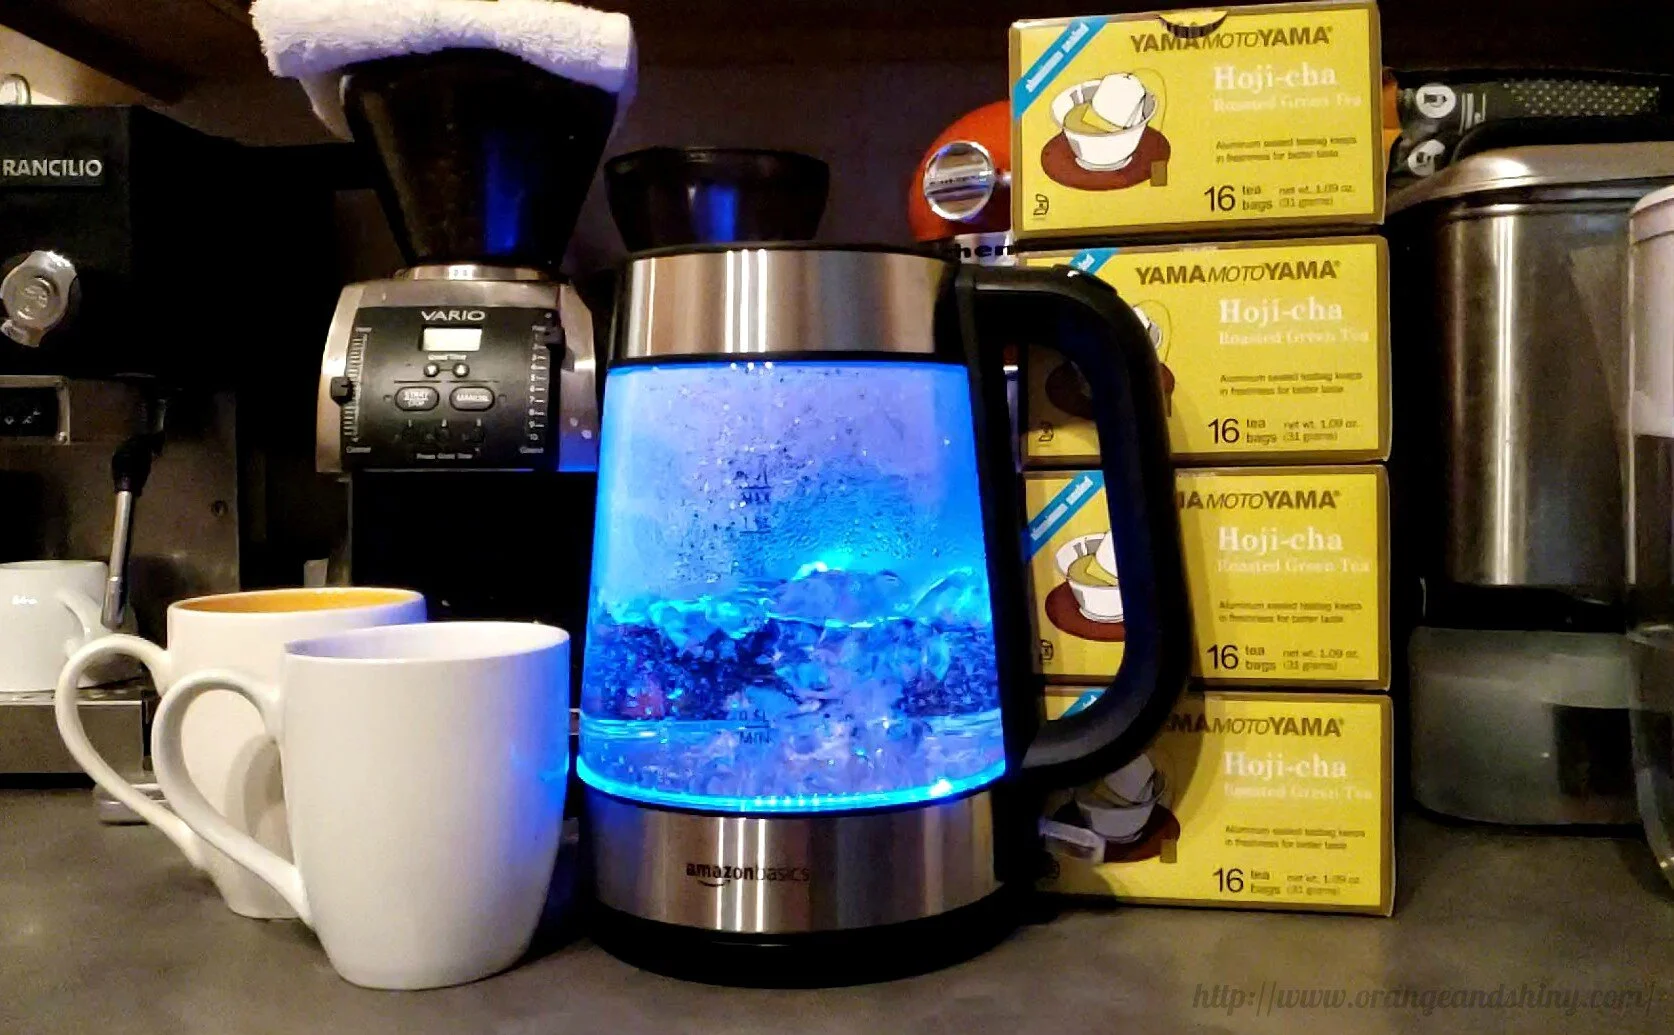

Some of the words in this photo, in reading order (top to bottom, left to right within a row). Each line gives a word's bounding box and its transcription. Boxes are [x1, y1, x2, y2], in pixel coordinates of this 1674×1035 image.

[1213, 62, 1337, 94] Hoji-cha
[1213, 96, 1276, 113] Roasted
[1282, 95, 1329, 109] Green
[1337, 93, 1362, 107] Tea
[2, 158, 103, 177] RANCILIO
[1204, 185, 1236, 212] 16
[1242, 185, 1261, 195] tea
[1242, 200, 1273, 212] bags
[1135, 260, 1336, 286] YAMAMOTOYAMA
[421, 310, 486, 321] VARIO
[1219, 295, 1343, 327] Hoji-cha
[1219, 330, 1282, 346] Roasted
[1286, 330, 1335, 343] Green
[1341, 327, 1369, 342] Tea
[1208, 418, 1240, 444] 16
[1246, 419, 1266, 429] tea
[1246, 433, 1277, 445] bags
[1218, 525, 1343, 555] Hoji-cha
[1217, 559, 1280, 573] Roasted
[1286, 559, 1336, 571] Green
[1342, 558, 1370, 572] Tea
[1207, 643, 1239, 670] 16
[1245, 645, 1265, 656] tea
[1245, 660, 1276, 673] bags
[1223, 751, 1347, 781] Hoji-cha
[1223, 783, 1287, 798] Roasted
[1291, 785, 1339, 799] Green
[1346, 786, 1373, 800] Tea
[1212, 867, 1244, 893] 16
